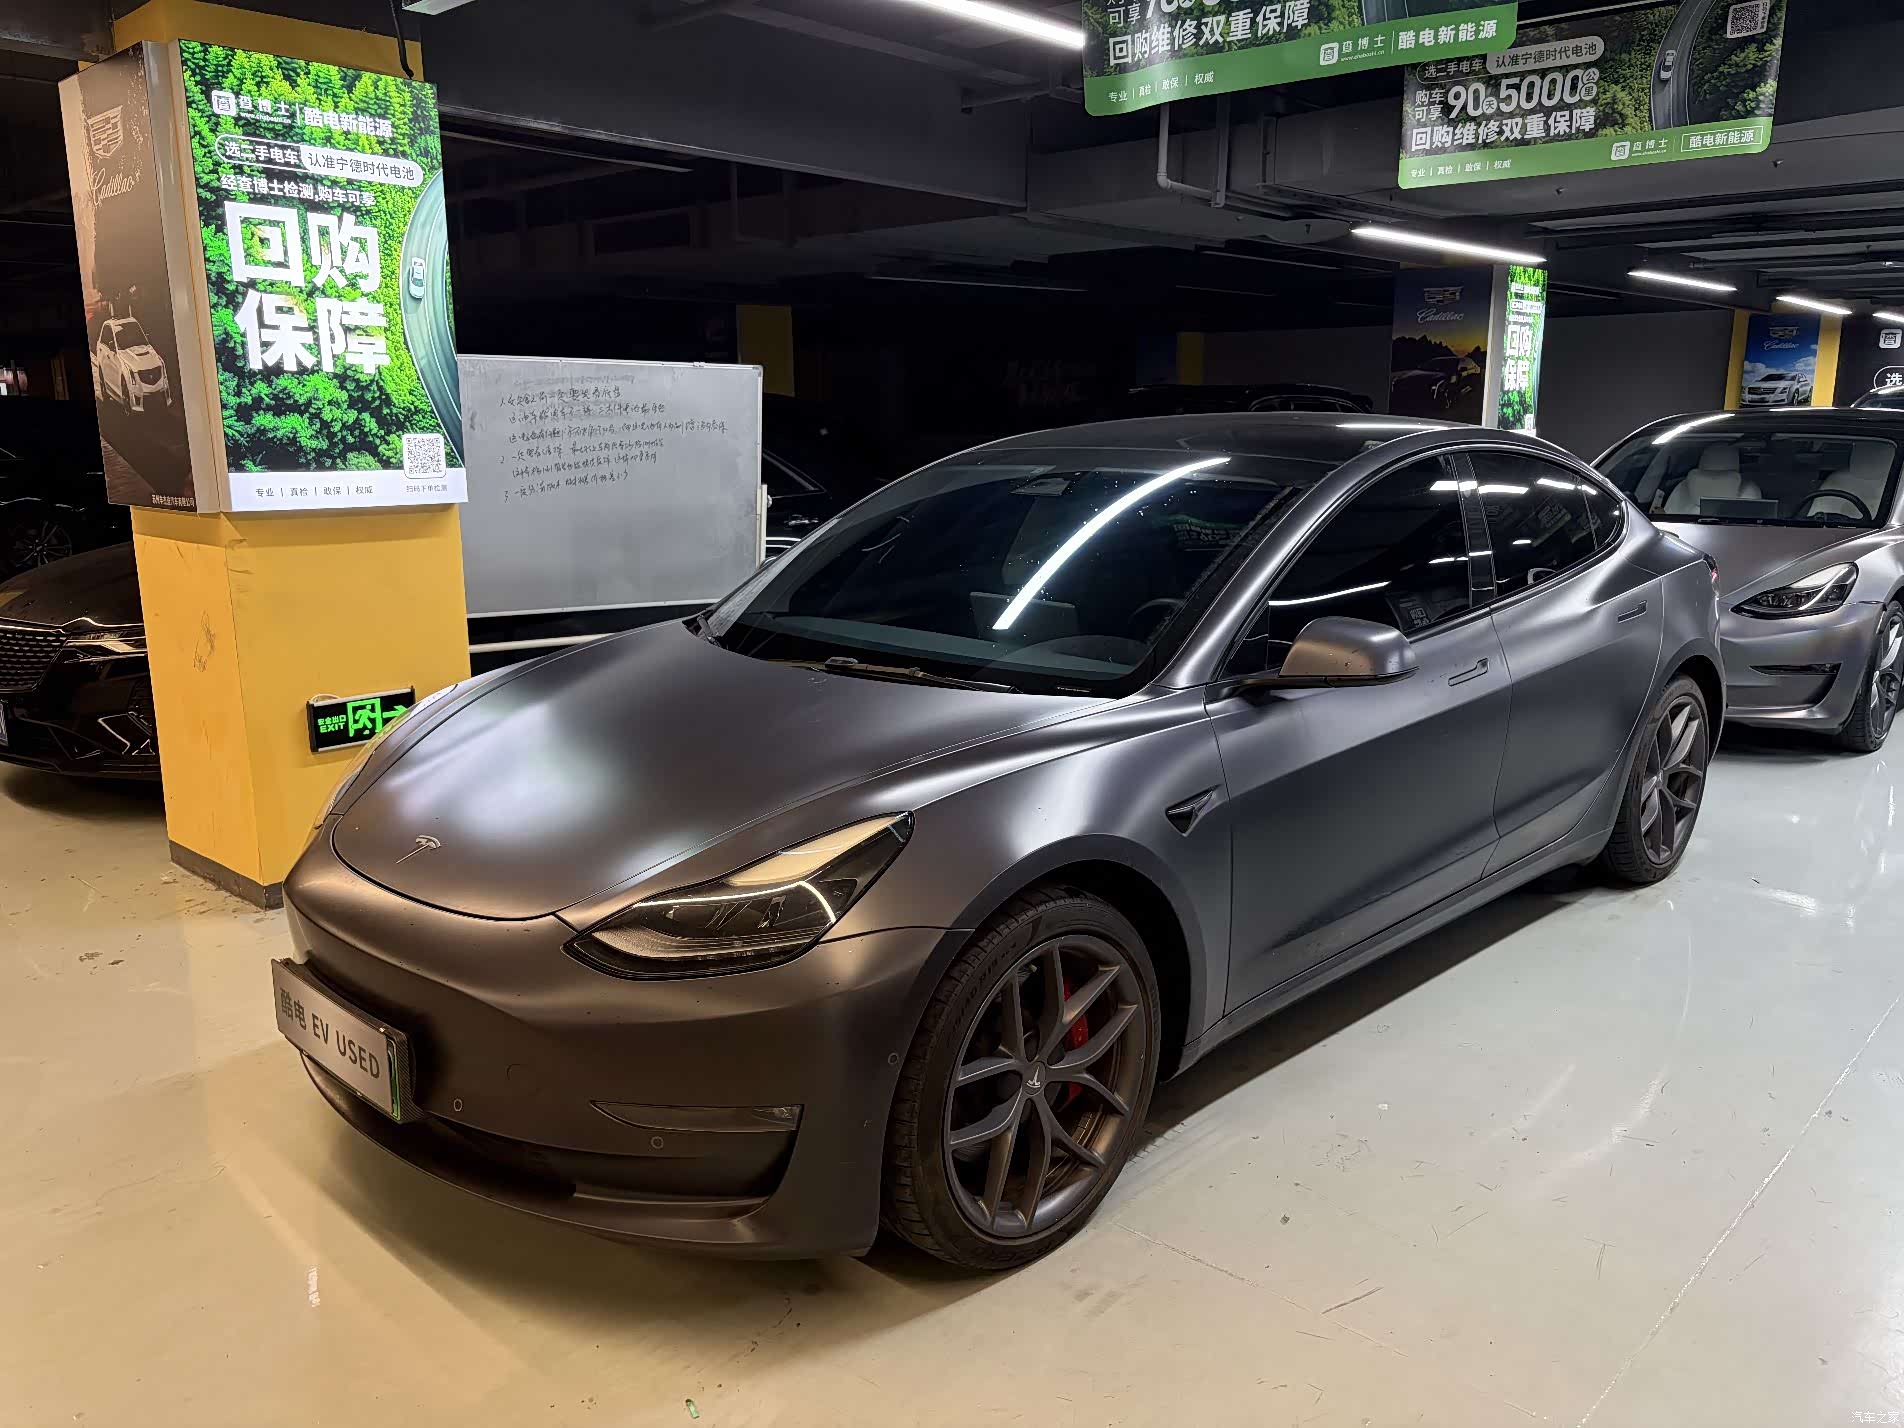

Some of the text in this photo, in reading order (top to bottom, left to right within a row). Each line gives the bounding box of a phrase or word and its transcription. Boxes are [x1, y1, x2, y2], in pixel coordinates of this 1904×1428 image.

[1108, 3, 1141, 27] 可享
[1109, 1, 1310, 66] 回购维修双重保障
[1398, 19, 1498, 50] 酷电新能源
[1424, 42, 1598, 79] 选二手电车 认准宁德时代电池
[1108, 91, 1128, 103] 专业
[1194, 71, 1214, 85] 权威
[1415, 89, 1446, 106] 购车
[304, 106, 392, 137] 酷电新能源
[1414, 104, 1444, 122] 可享
[1411, 107, 1596, 152] 回购维修双重保障
[1689, 130, 1754, 148] 酷电新能源
[225, 141, 415, 181] 选二手电车 认准宁德时代电池
[1410, 169, 1425, 178] 专业
[91, 167, 135, 206] Cadillac
[224, 201, 381, 292] 回购
[1417, 308, 1464, 323] Cadillac
[234, 289, 390, 374] 保障
[256, 488, 275, 497] 专业
[356, 485, 373, 495] 权威
[318, 715, 347, 726] 安全出口
[320, 722, 345, 733] EXIT
[280, 988, 380, 1079] 酷电 EV USED
